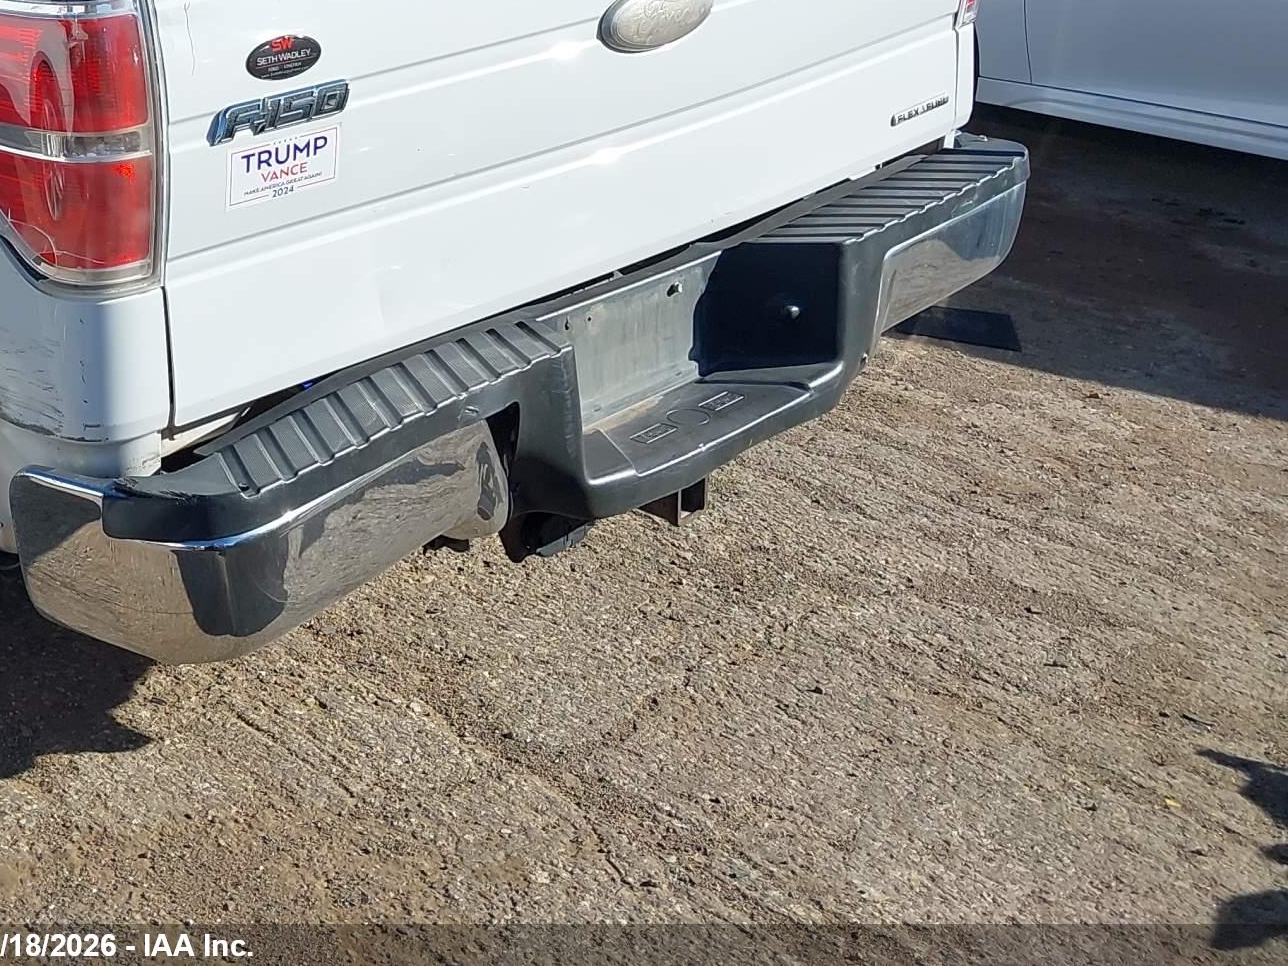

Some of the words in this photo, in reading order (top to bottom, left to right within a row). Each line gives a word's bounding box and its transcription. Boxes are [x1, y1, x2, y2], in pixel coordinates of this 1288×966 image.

[256, 55, 279, 66] SETH
[279, 48, 312, 62] WADLEY
[241, 136, 328, 173] TRUMP
[261, 161, 308, 183] VANCE
[272, 185, 294, 198] 2024
